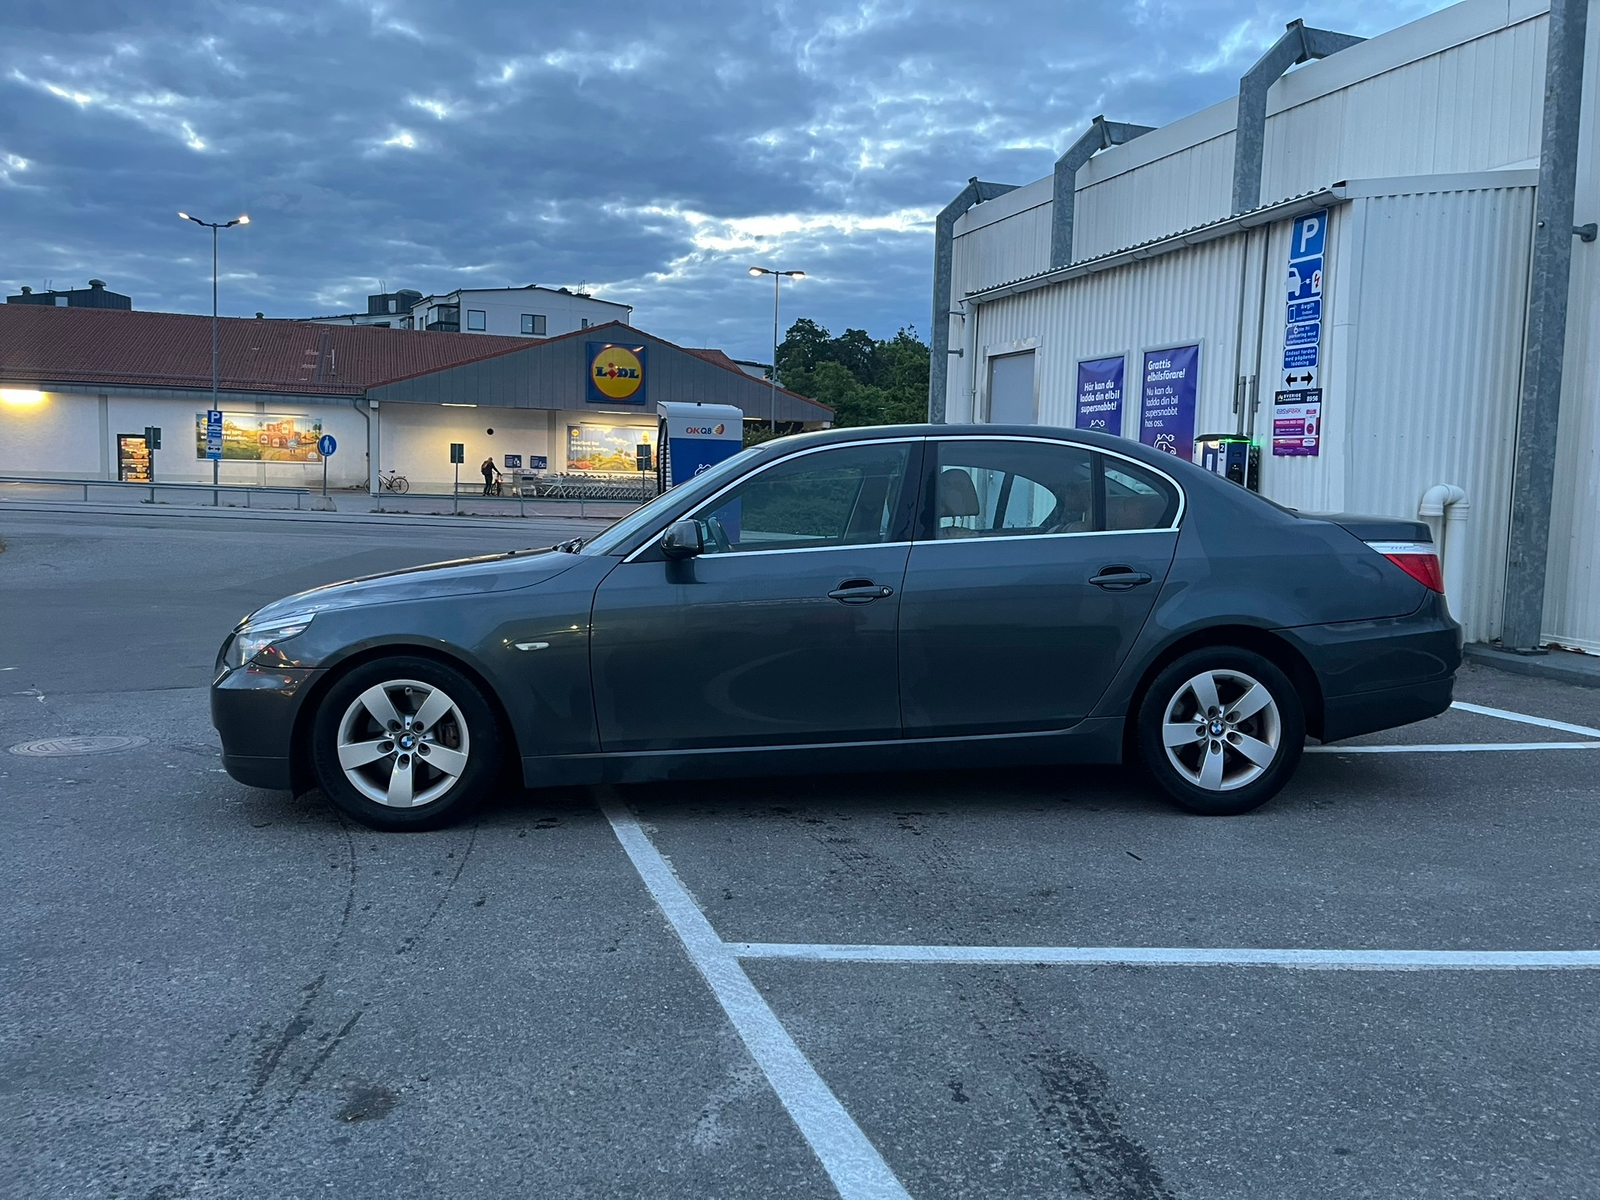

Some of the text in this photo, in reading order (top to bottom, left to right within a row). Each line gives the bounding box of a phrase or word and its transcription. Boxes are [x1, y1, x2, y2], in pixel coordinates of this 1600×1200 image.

[1300, 218, 1319, 252] P
[1148, 359, 1171, 370] Grattis
[1147, 369, 1186, 382] elbilsförare!
[1084, 380, 1114, 391] Här kan du
[1146, 385, 1173, 396] Nu kan du
[1080, 390, 1120, 403] ladda din elbil
[1146, 395, 1179, 407] ladda din bil
[1080, 401, 1117, 414] supersnabbt!
[1145, 406, 1178, 419] supersnabbt
[211, 411, 221, 423] P
[1145, 418, 1164, 428] hos oss.
[685, 426, 712, 435] OKQ8
[1220, 444, 1225, 452] 2
